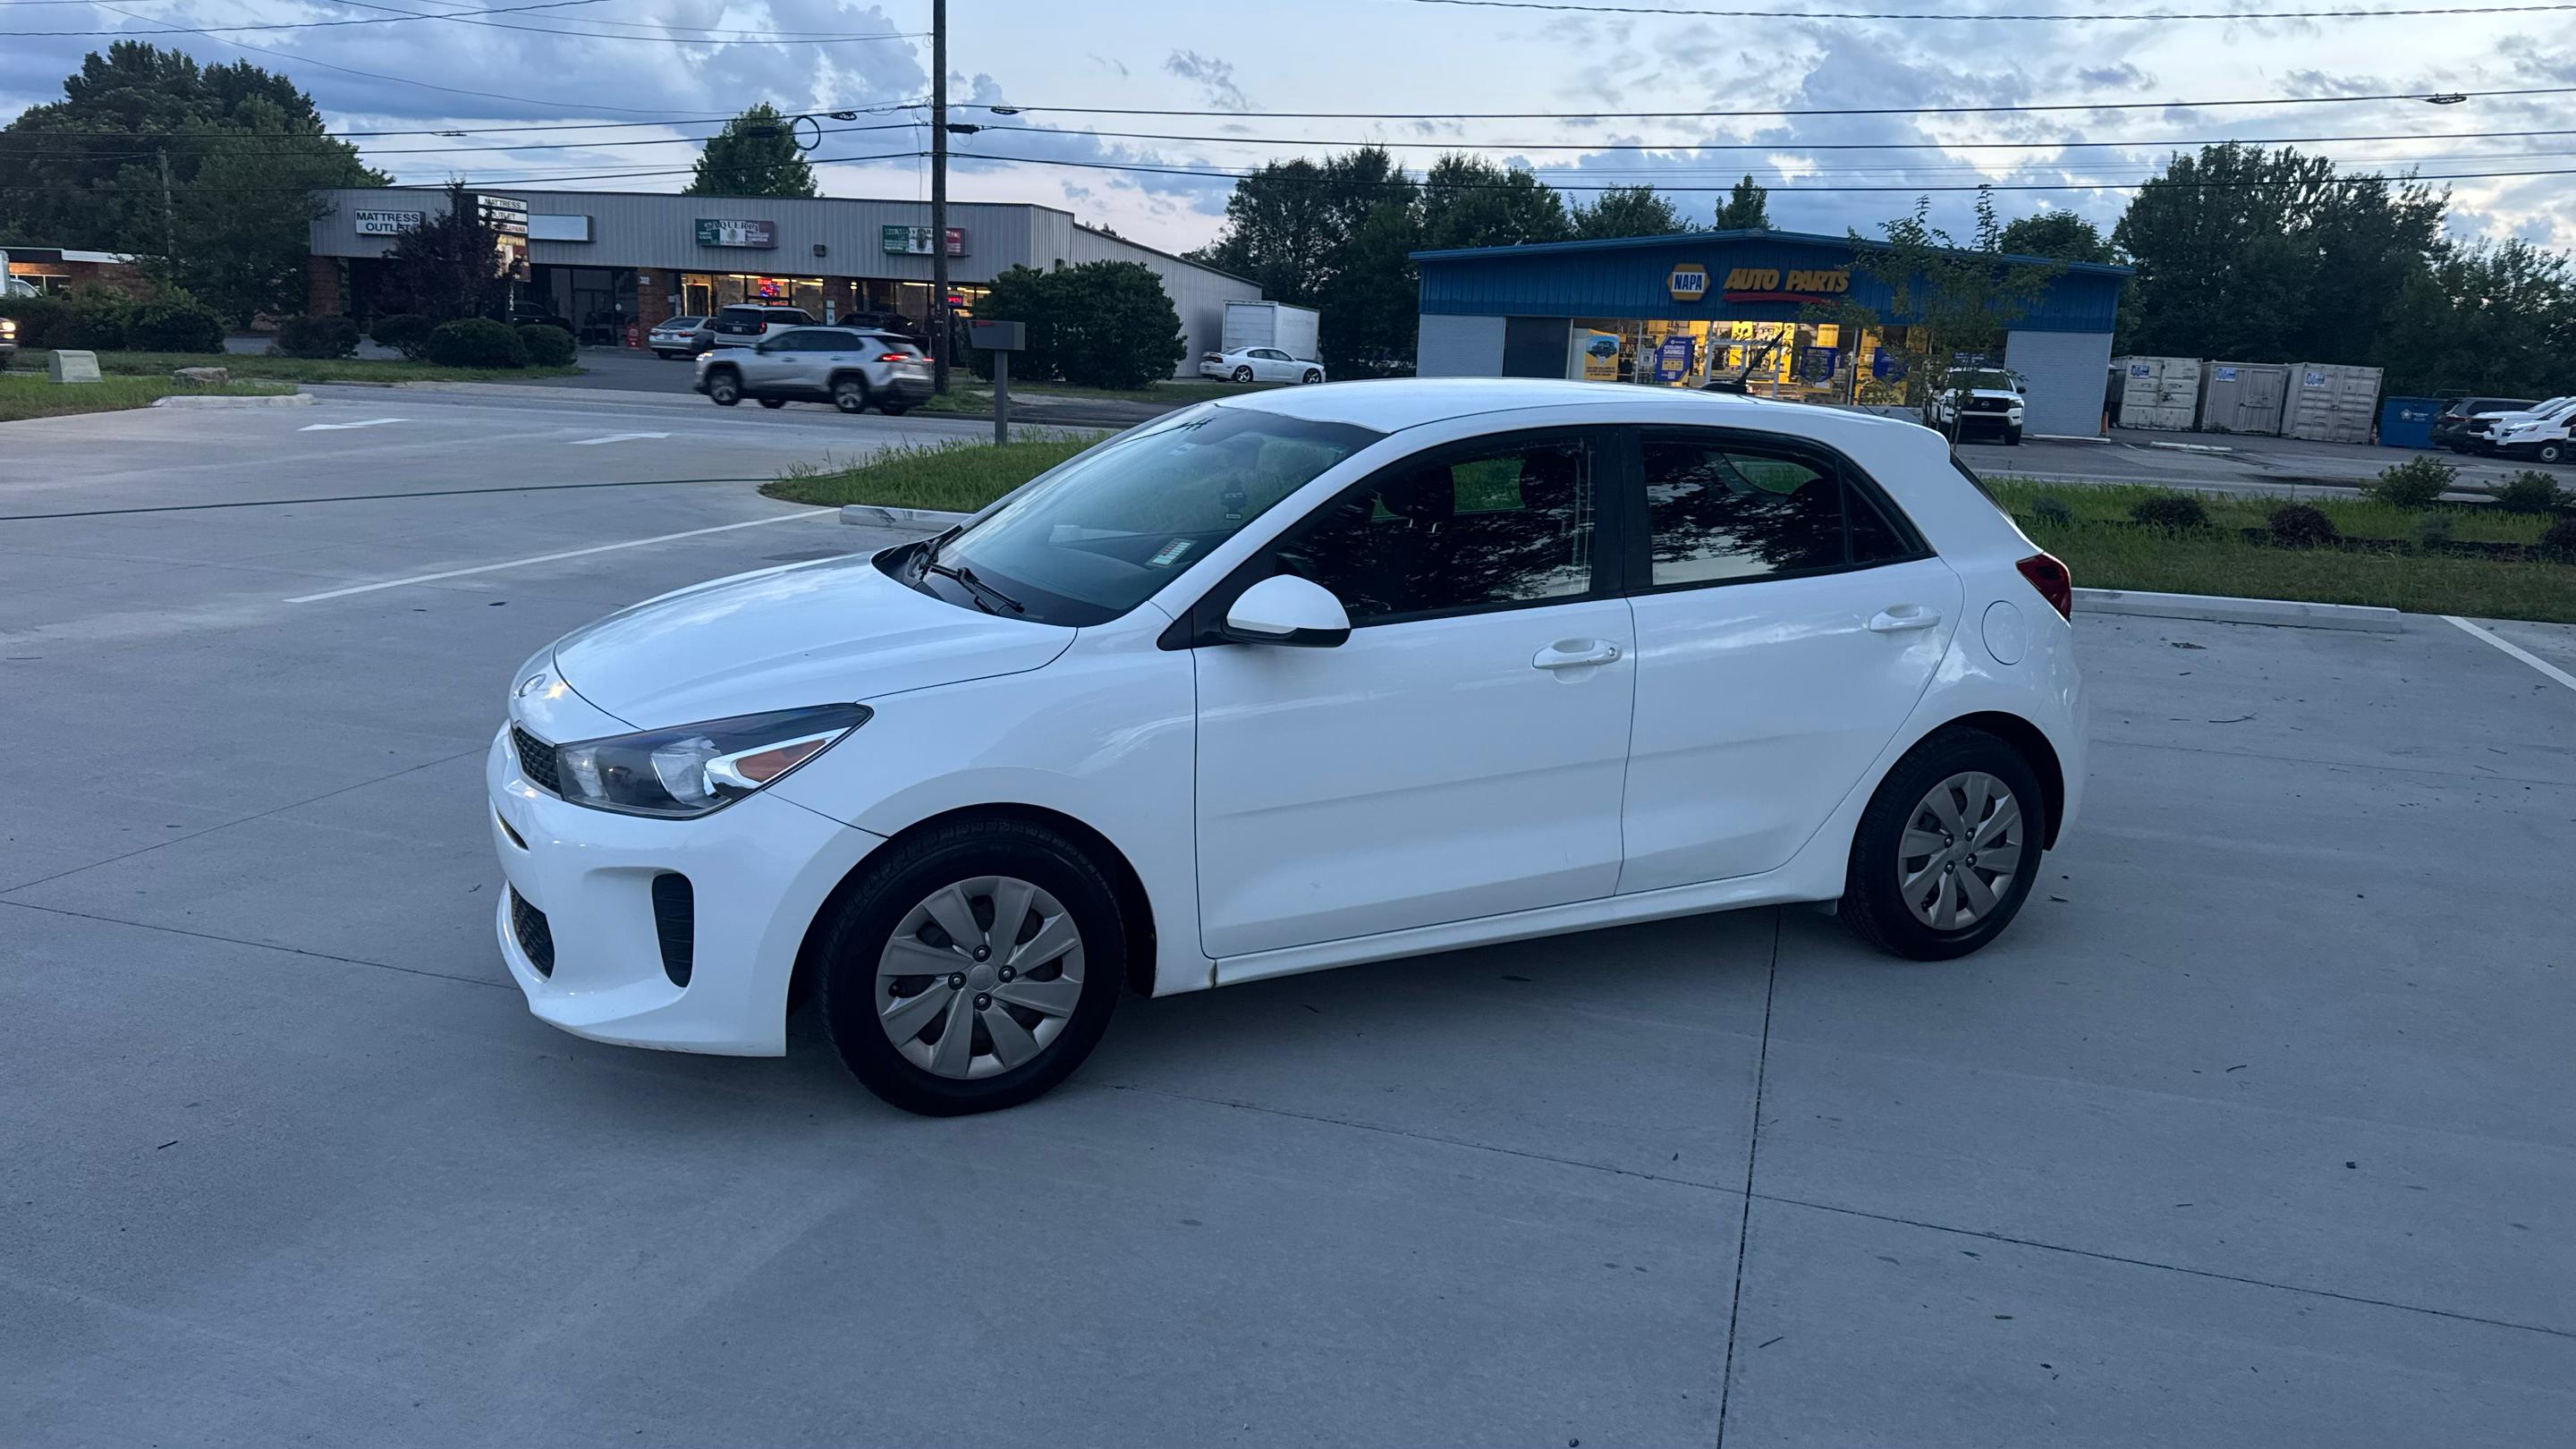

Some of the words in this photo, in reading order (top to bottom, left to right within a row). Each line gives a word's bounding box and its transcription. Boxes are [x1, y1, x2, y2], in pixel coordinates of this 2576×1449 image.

[484, 198, 522, 209] MATTRESS
[356, 211, 419, 223] MATTRESS
[1674, 274, 1703, 291] NAPA
[1723, 268, 1781, 291] AUTO
[1784, 269, 1851, 293] PARTS
